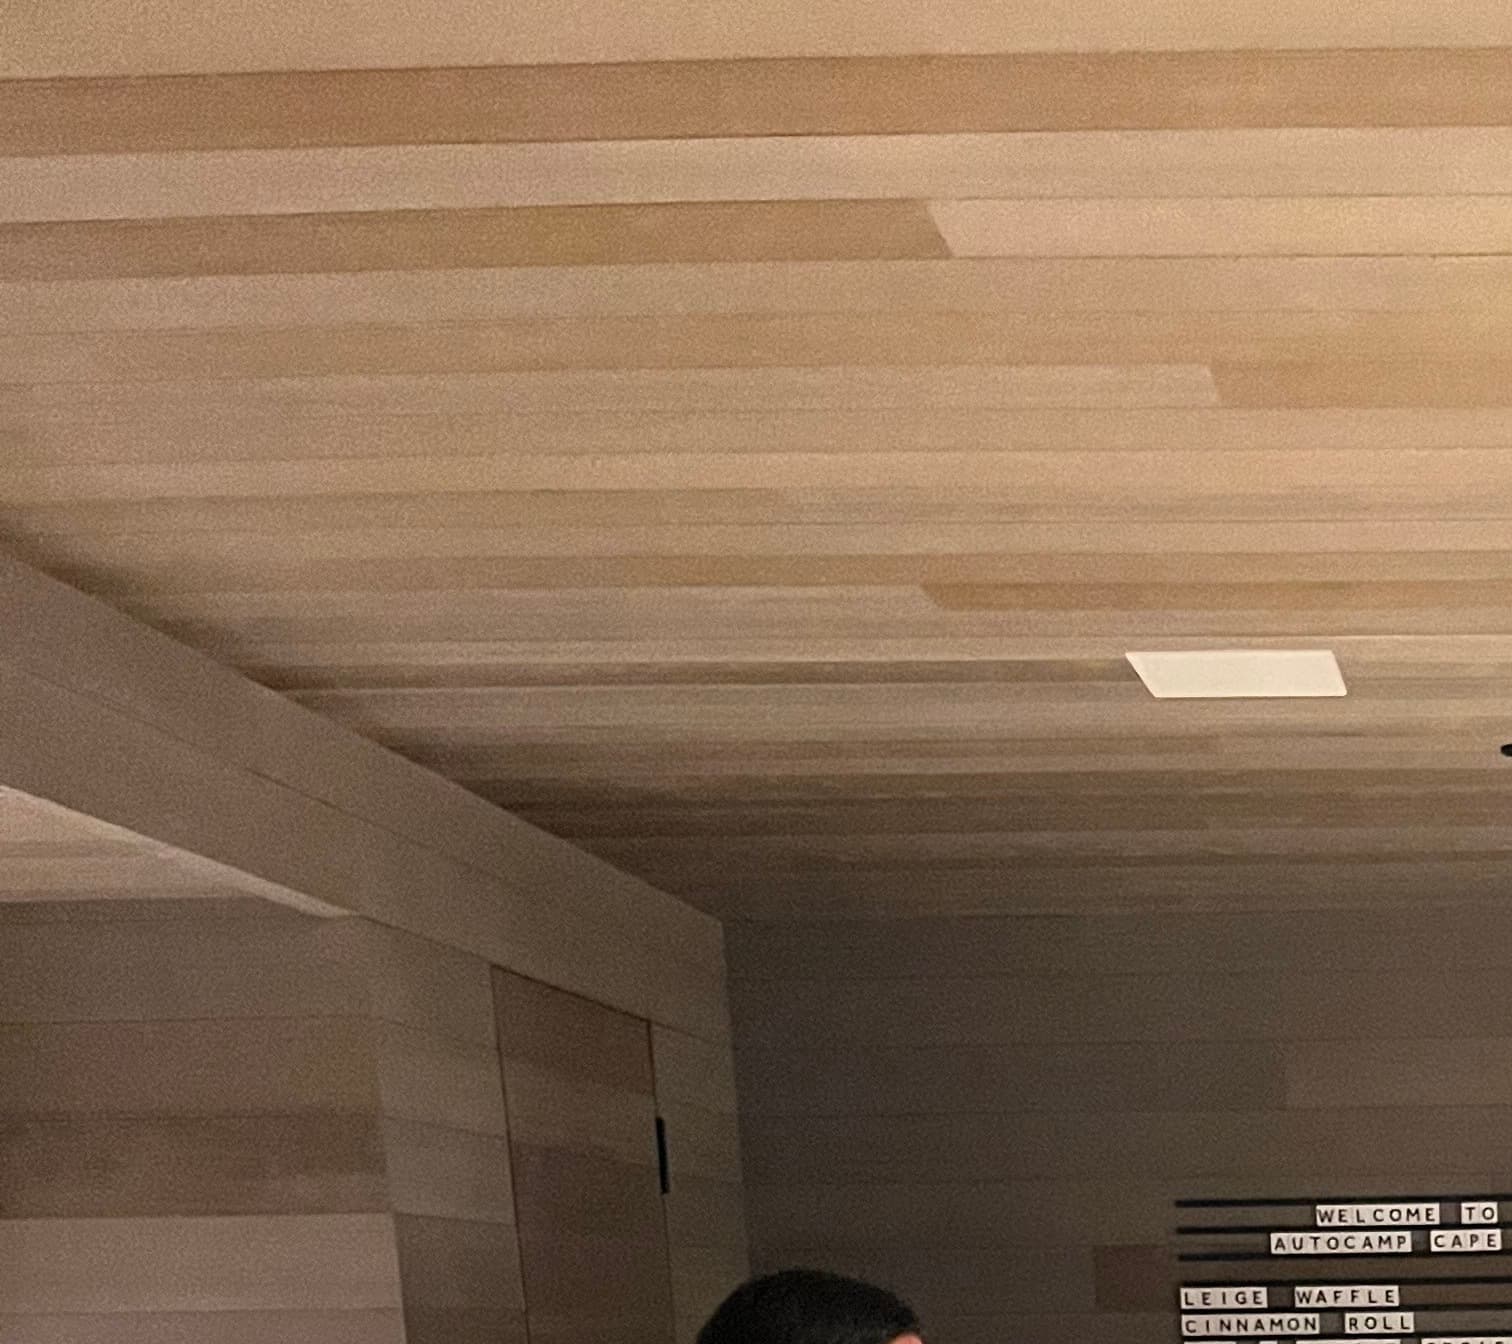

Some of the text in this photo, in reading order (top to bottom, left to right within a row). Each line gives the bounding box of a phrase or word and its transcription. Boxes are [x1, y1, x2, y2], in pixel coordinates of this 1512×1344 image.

[1317, 1207, 1496, 1223] WELCOME TO
[1274, 1234, 1407, 1251] AUTOCAMP
[1434, 1233, 1497, 1248] CAPE
[1184, 1291, 1263, 1306] LEIGE
[1296, 1289, 1395, 1305] WAFFLE
[1185, 1317, 1317, 1333] CINNAMON
[1349, 1316, 1411, 1331] ROLL
